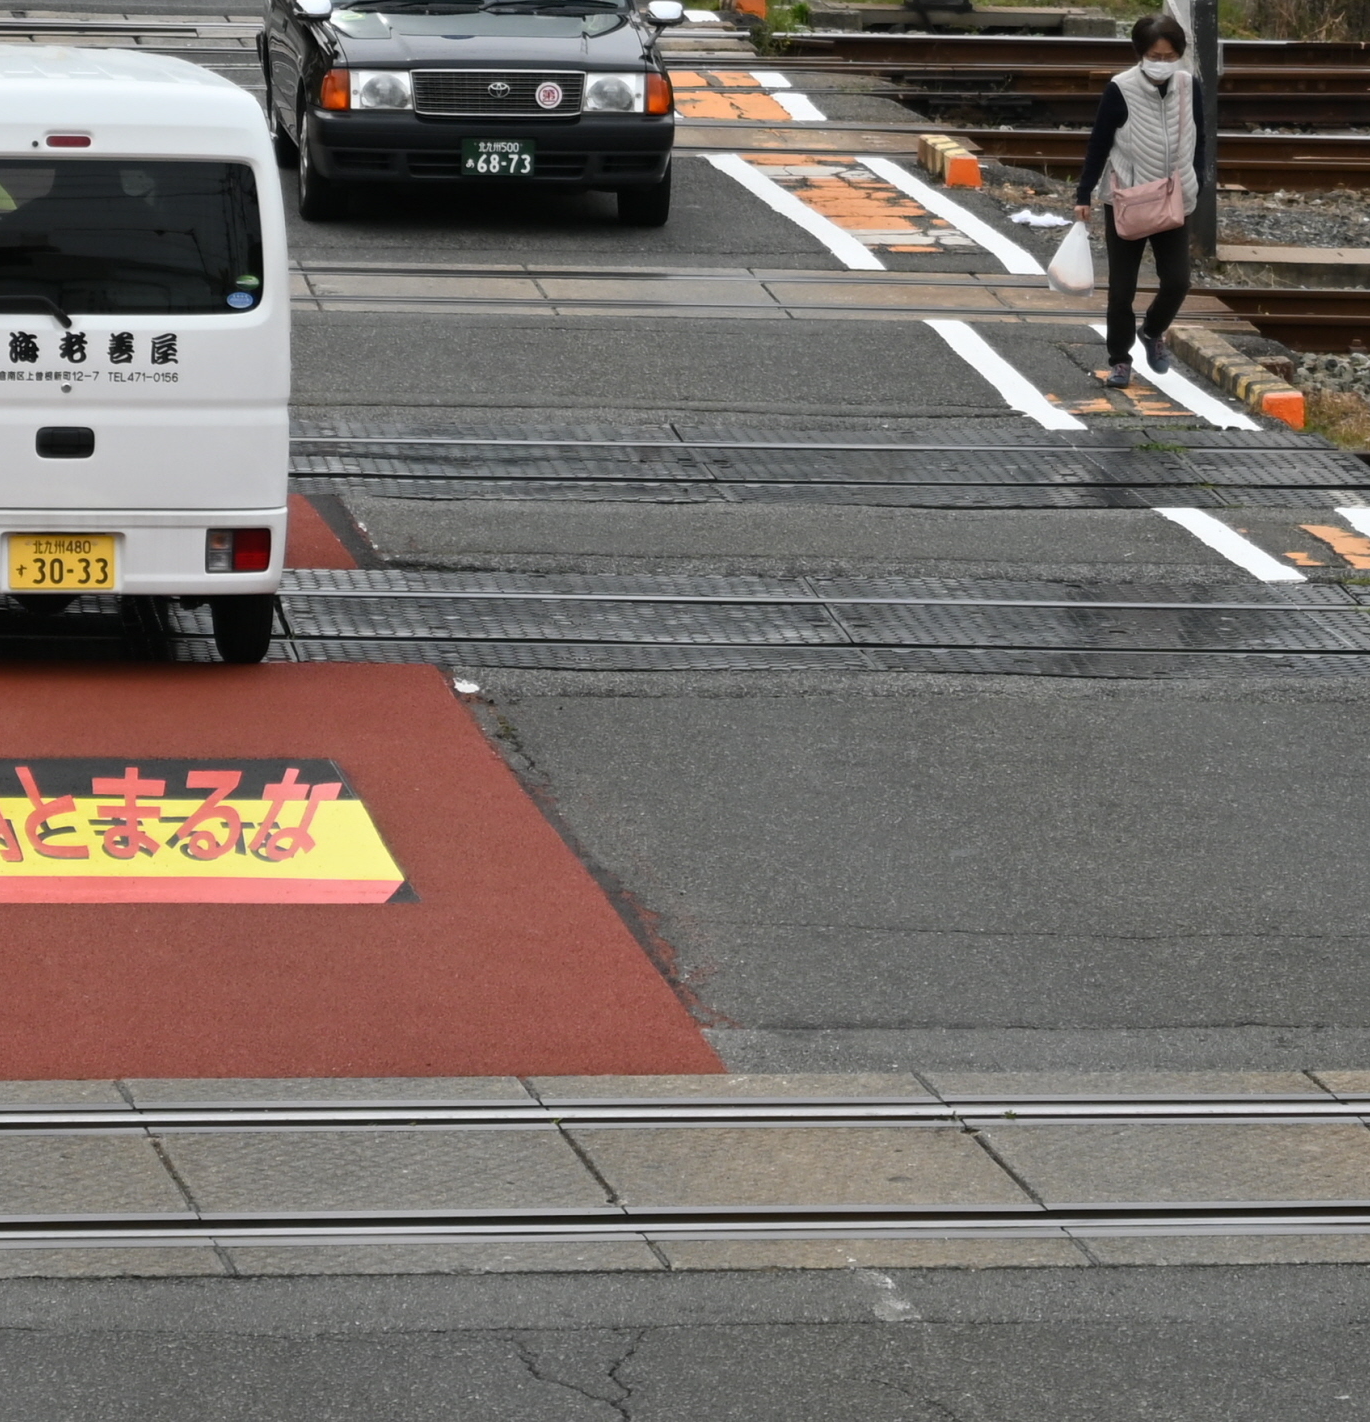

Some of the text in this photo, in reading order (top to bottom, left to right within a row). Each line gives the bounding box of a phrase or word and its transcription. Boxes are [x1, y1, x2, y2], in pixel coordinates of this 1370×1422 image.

[478, 141, 520, 153] 北九州500
[465, 154, 531, 173] あ 68-73
[32, 540, 92, 554] 北九州480
[16, 558, 109, 584] す 30-33
